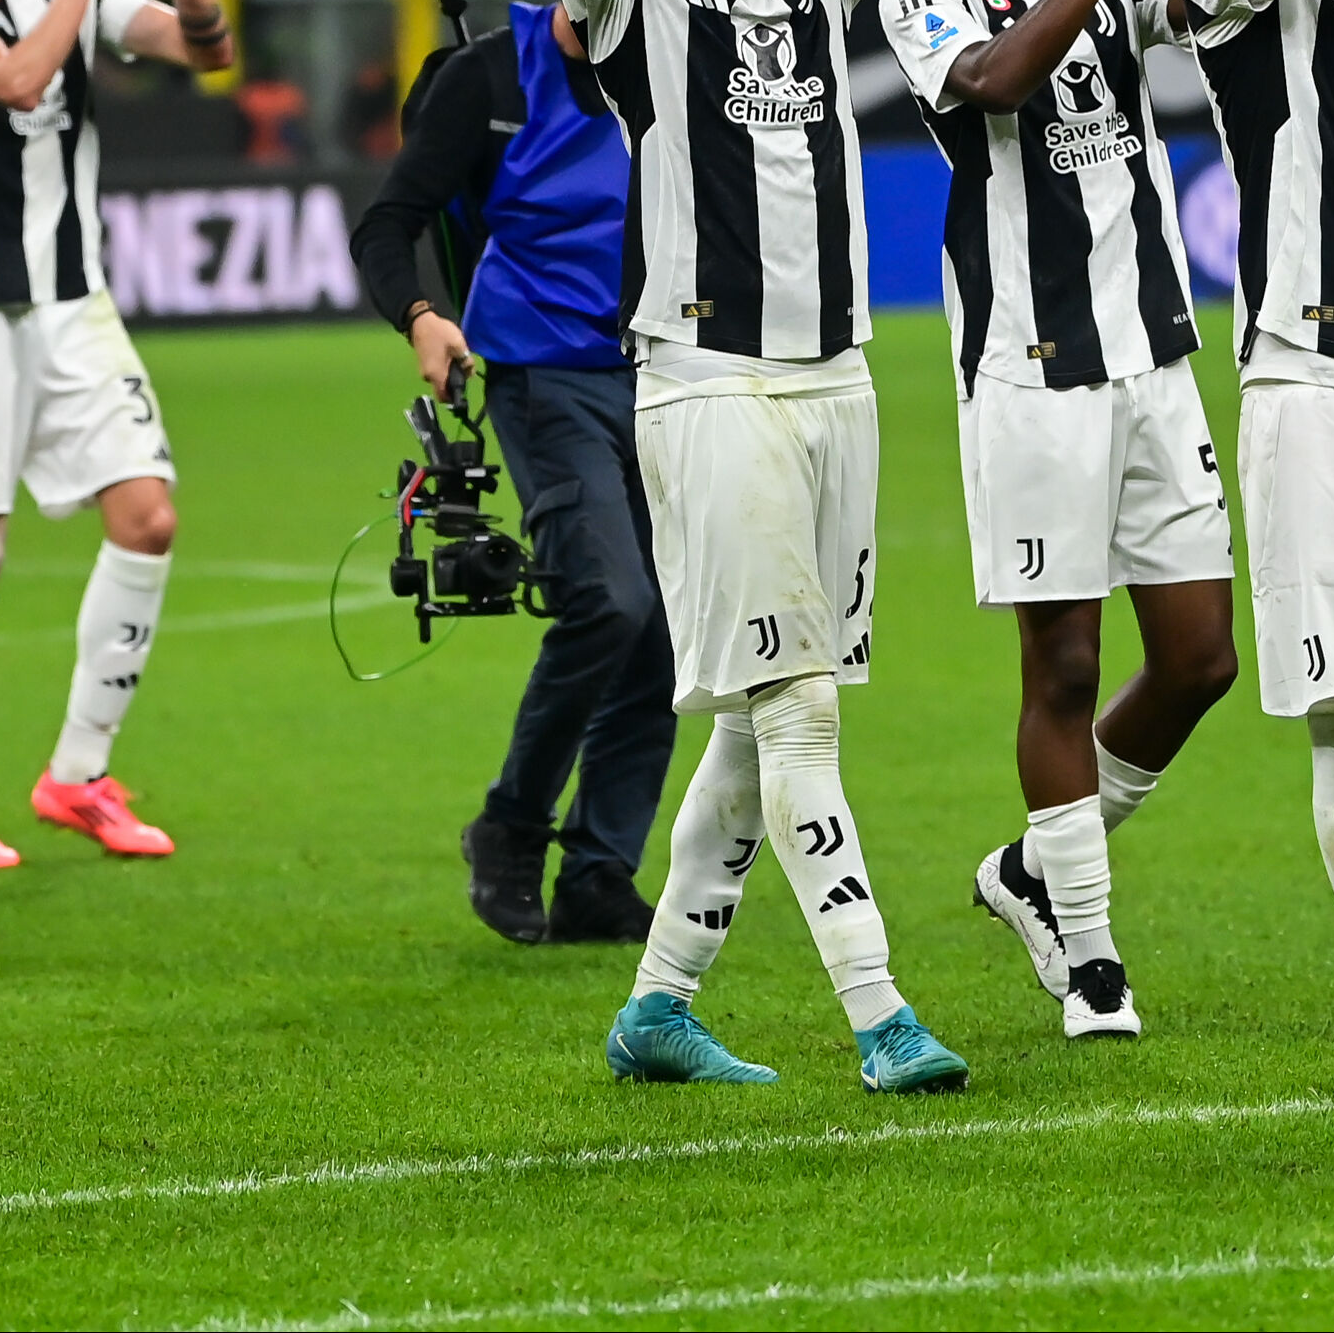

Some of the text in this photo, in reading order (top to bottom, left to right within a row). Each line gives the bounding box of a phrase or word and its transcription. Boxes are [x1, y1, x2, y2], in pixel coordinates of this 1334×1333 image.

[727, 98, 821, 123] Children
[1046, 112, 1126, 147] Save the
[1052, 137, 1139, 171] Children
[98, 184, 361, 316] NEZIA
